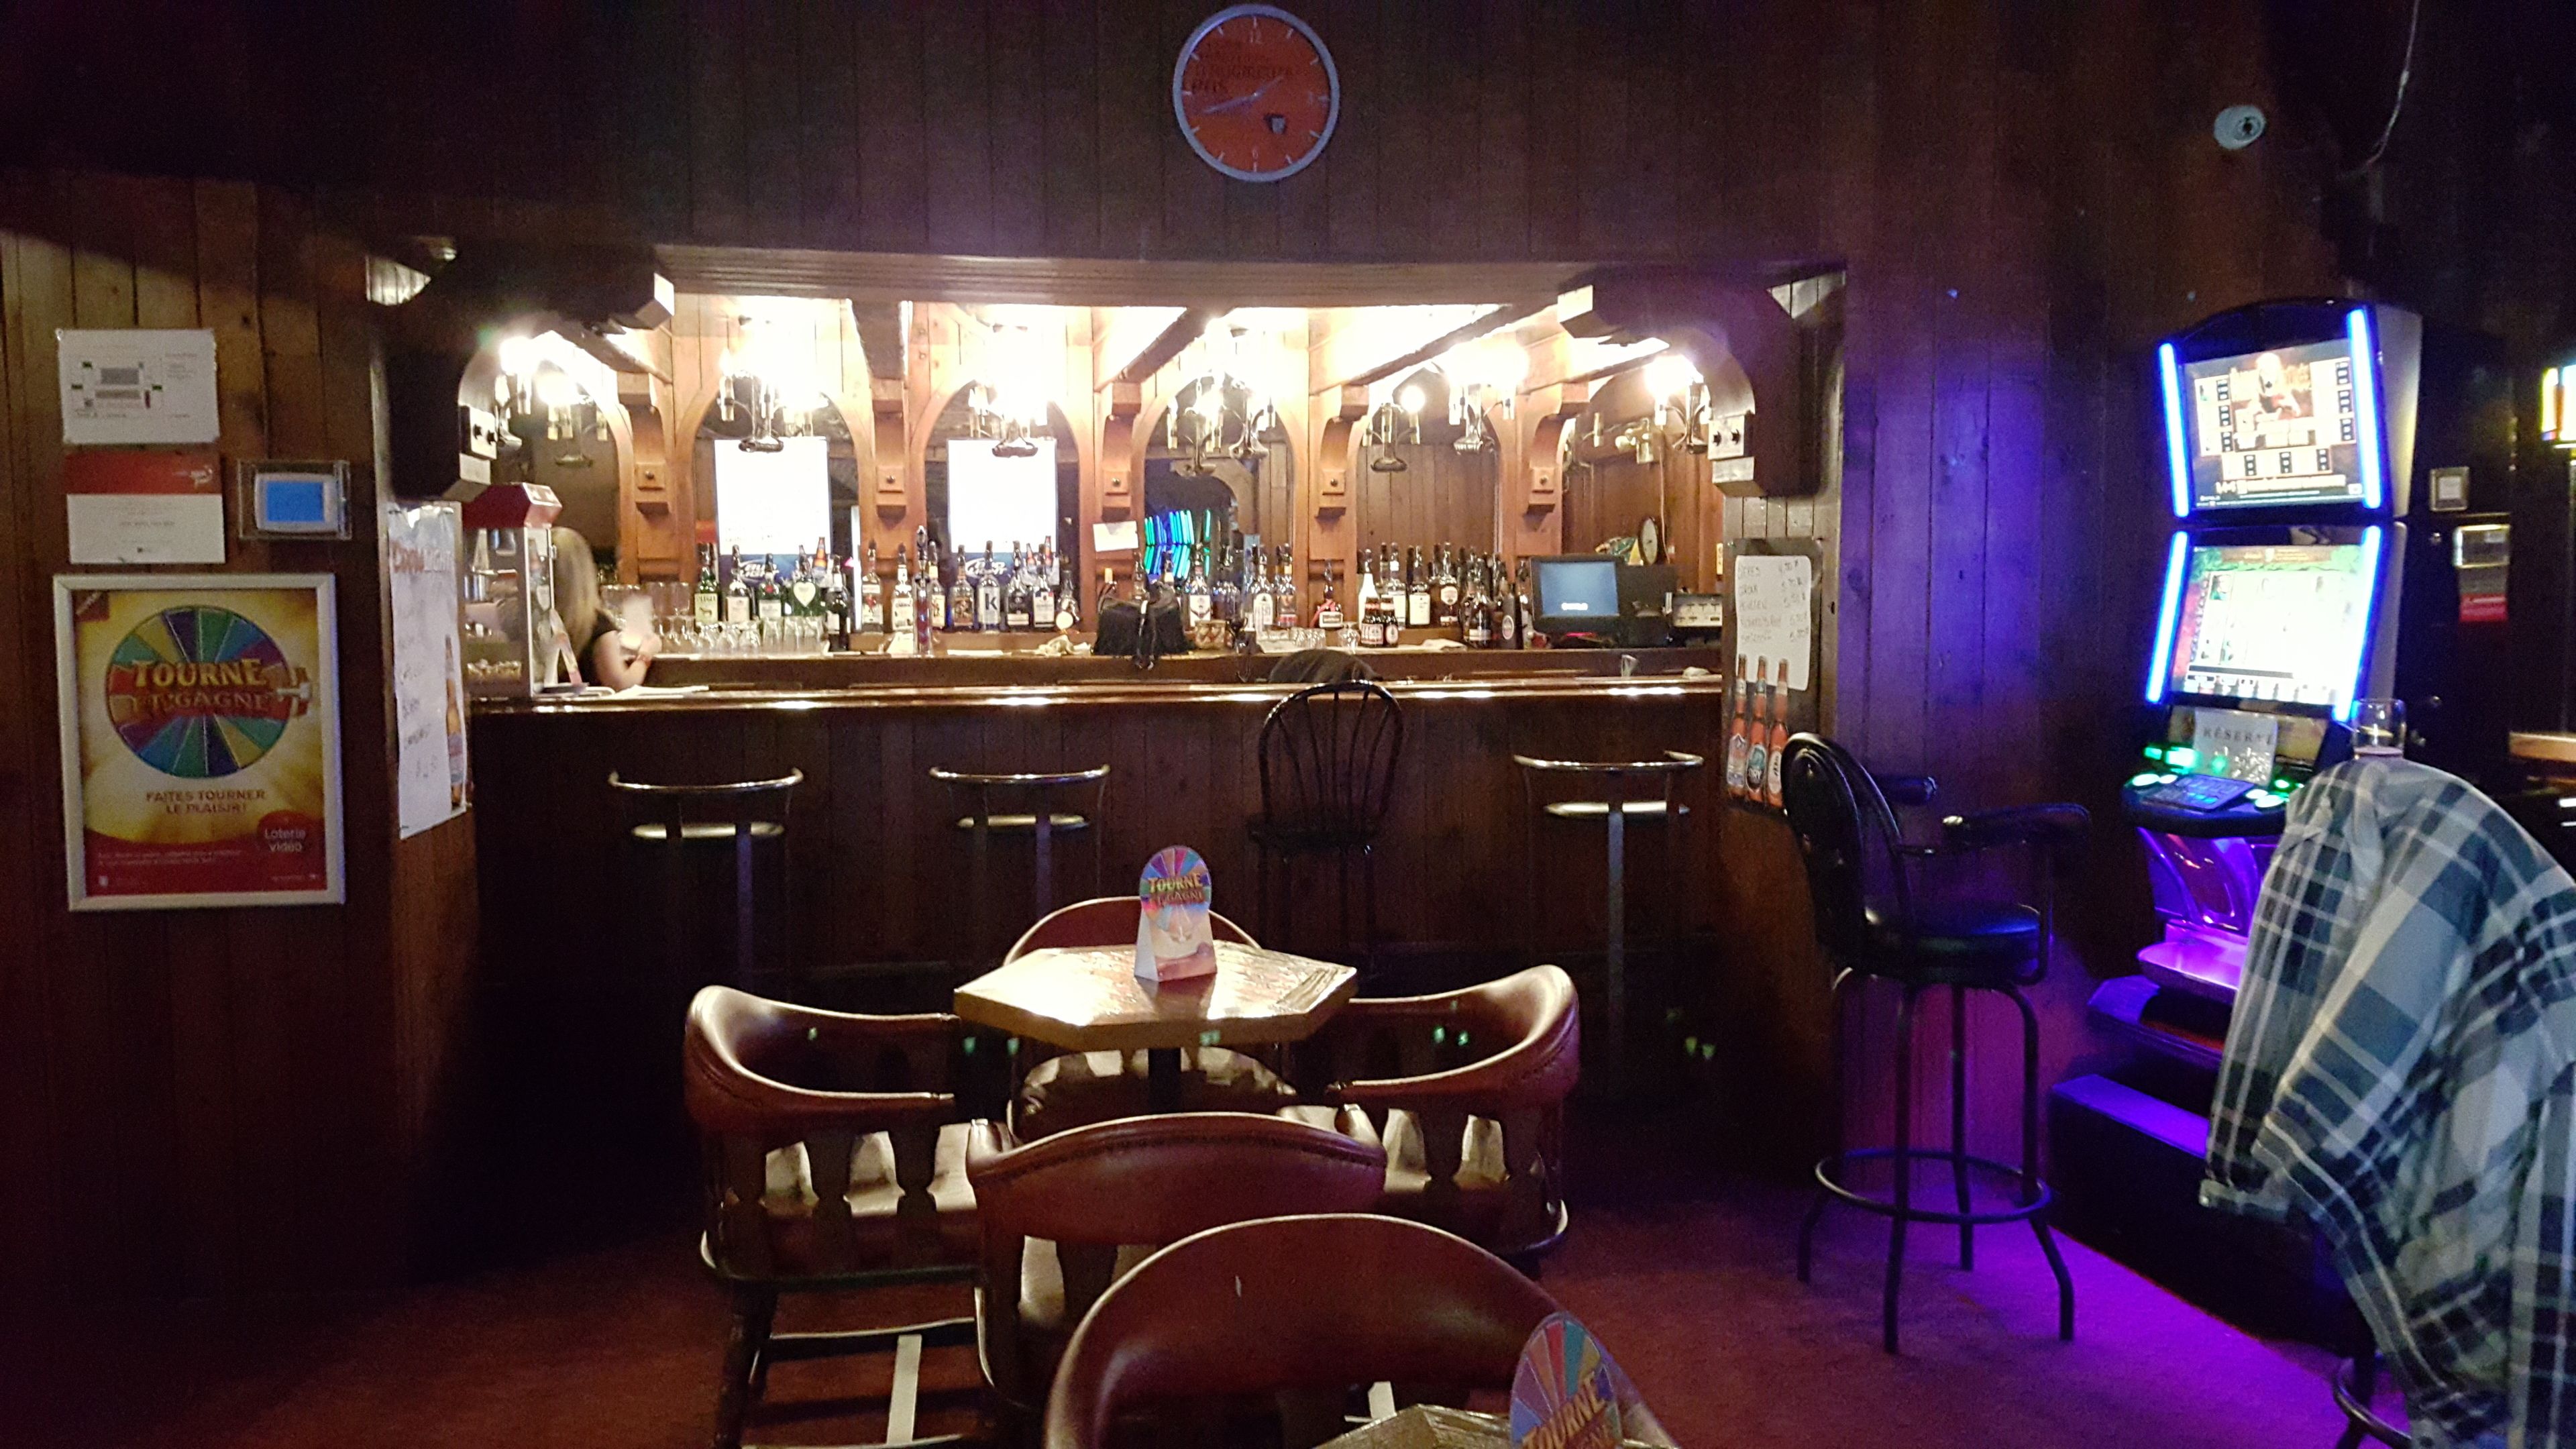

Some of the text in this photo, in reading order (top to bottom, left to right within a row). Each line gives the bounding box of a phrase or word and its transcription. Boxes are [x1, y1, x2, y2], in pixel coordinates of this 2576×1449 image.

[131, 658, 267, 688] TOURNE
[146, 788, 266, 802] FAITES TOURNER
[1148, 871, 1203, 894] TOURNE
